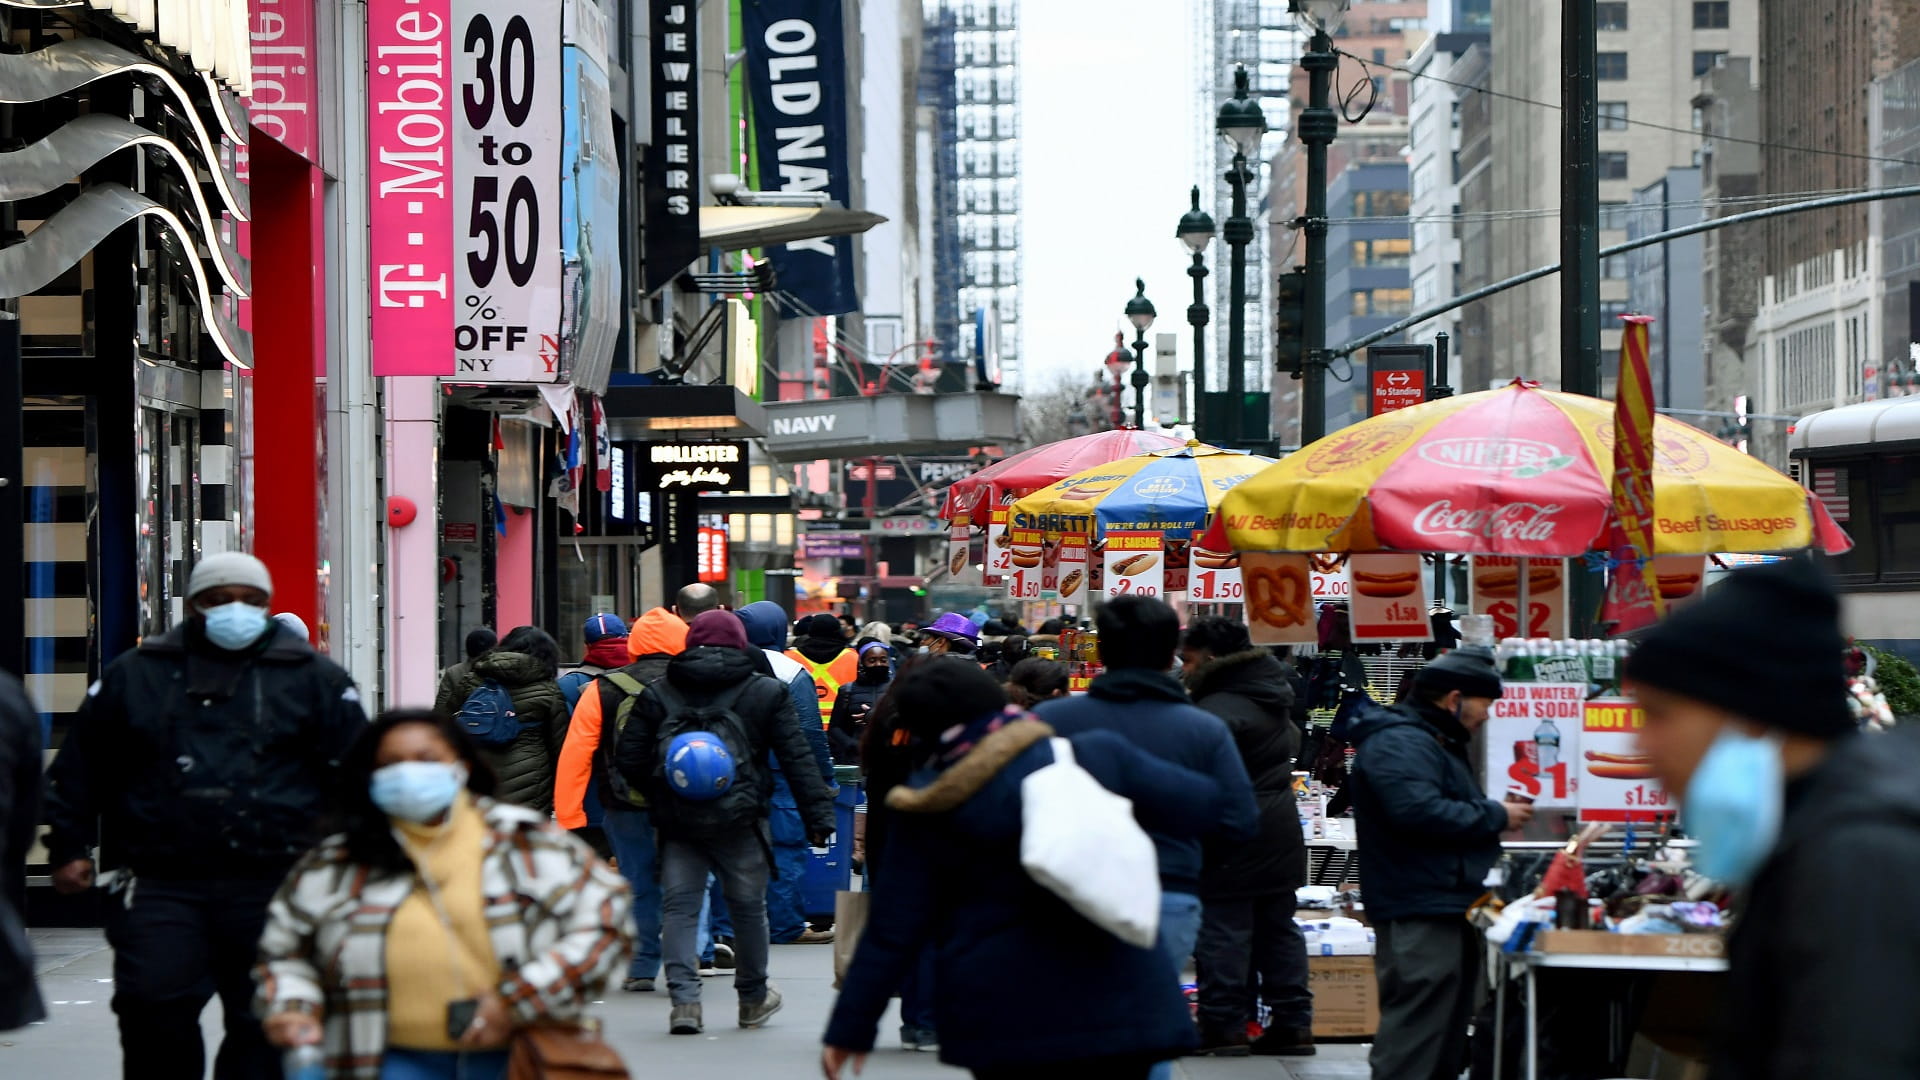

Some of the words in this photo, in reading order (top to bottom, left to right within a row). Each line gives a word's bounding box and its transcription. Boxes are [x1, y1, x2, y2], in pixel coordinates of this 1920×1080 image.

[462, 13, 535, 131] 30
[764, 18, 821, 116] OLD
[663, 4, 690, 216] JEWELERS
[478, 135, 533, 166] to
[775, 124, 836, 258] NAY
[466, 175, 540, 289] 50
[465, 295, 497, 320] %
[454, 325, 527, 352] OFF
[459, 358, 494, 372] NY
[1376, 388, 1387, 396] No
[1388, 386, 1421, 398] Standing
[773, 414, 836, 434] NAVY
[650, 445, 739, 463] HOLLISTER
[1160, 521, 1183, 529] ROLL
[1227, 515, 1249, 530] All
[1249, 513, 1286, 530] Beef
[1658, 516, 1702, 534] Beef
[1706, 514, 1797, 535] Sausages
[1107, 536, 1124, 548] HOT
[1124, 536, 1160, 549] SAUSAGE
[1010, 569, 1039, 598] $1.50
[1193, 570, 1242, 600] $1.50
[1386, 602, 1418, 622] $1.50
[1486, 600, 1550, 639] $2
[1502, 687, 1526, 700] OLD
[1495, 702, 1529, 718] CAN
[1534, 702, 1579, 718] SODA
[1585, 708, 1628, 728] HOT
[1625, 784, 1668, 806] $1.50
